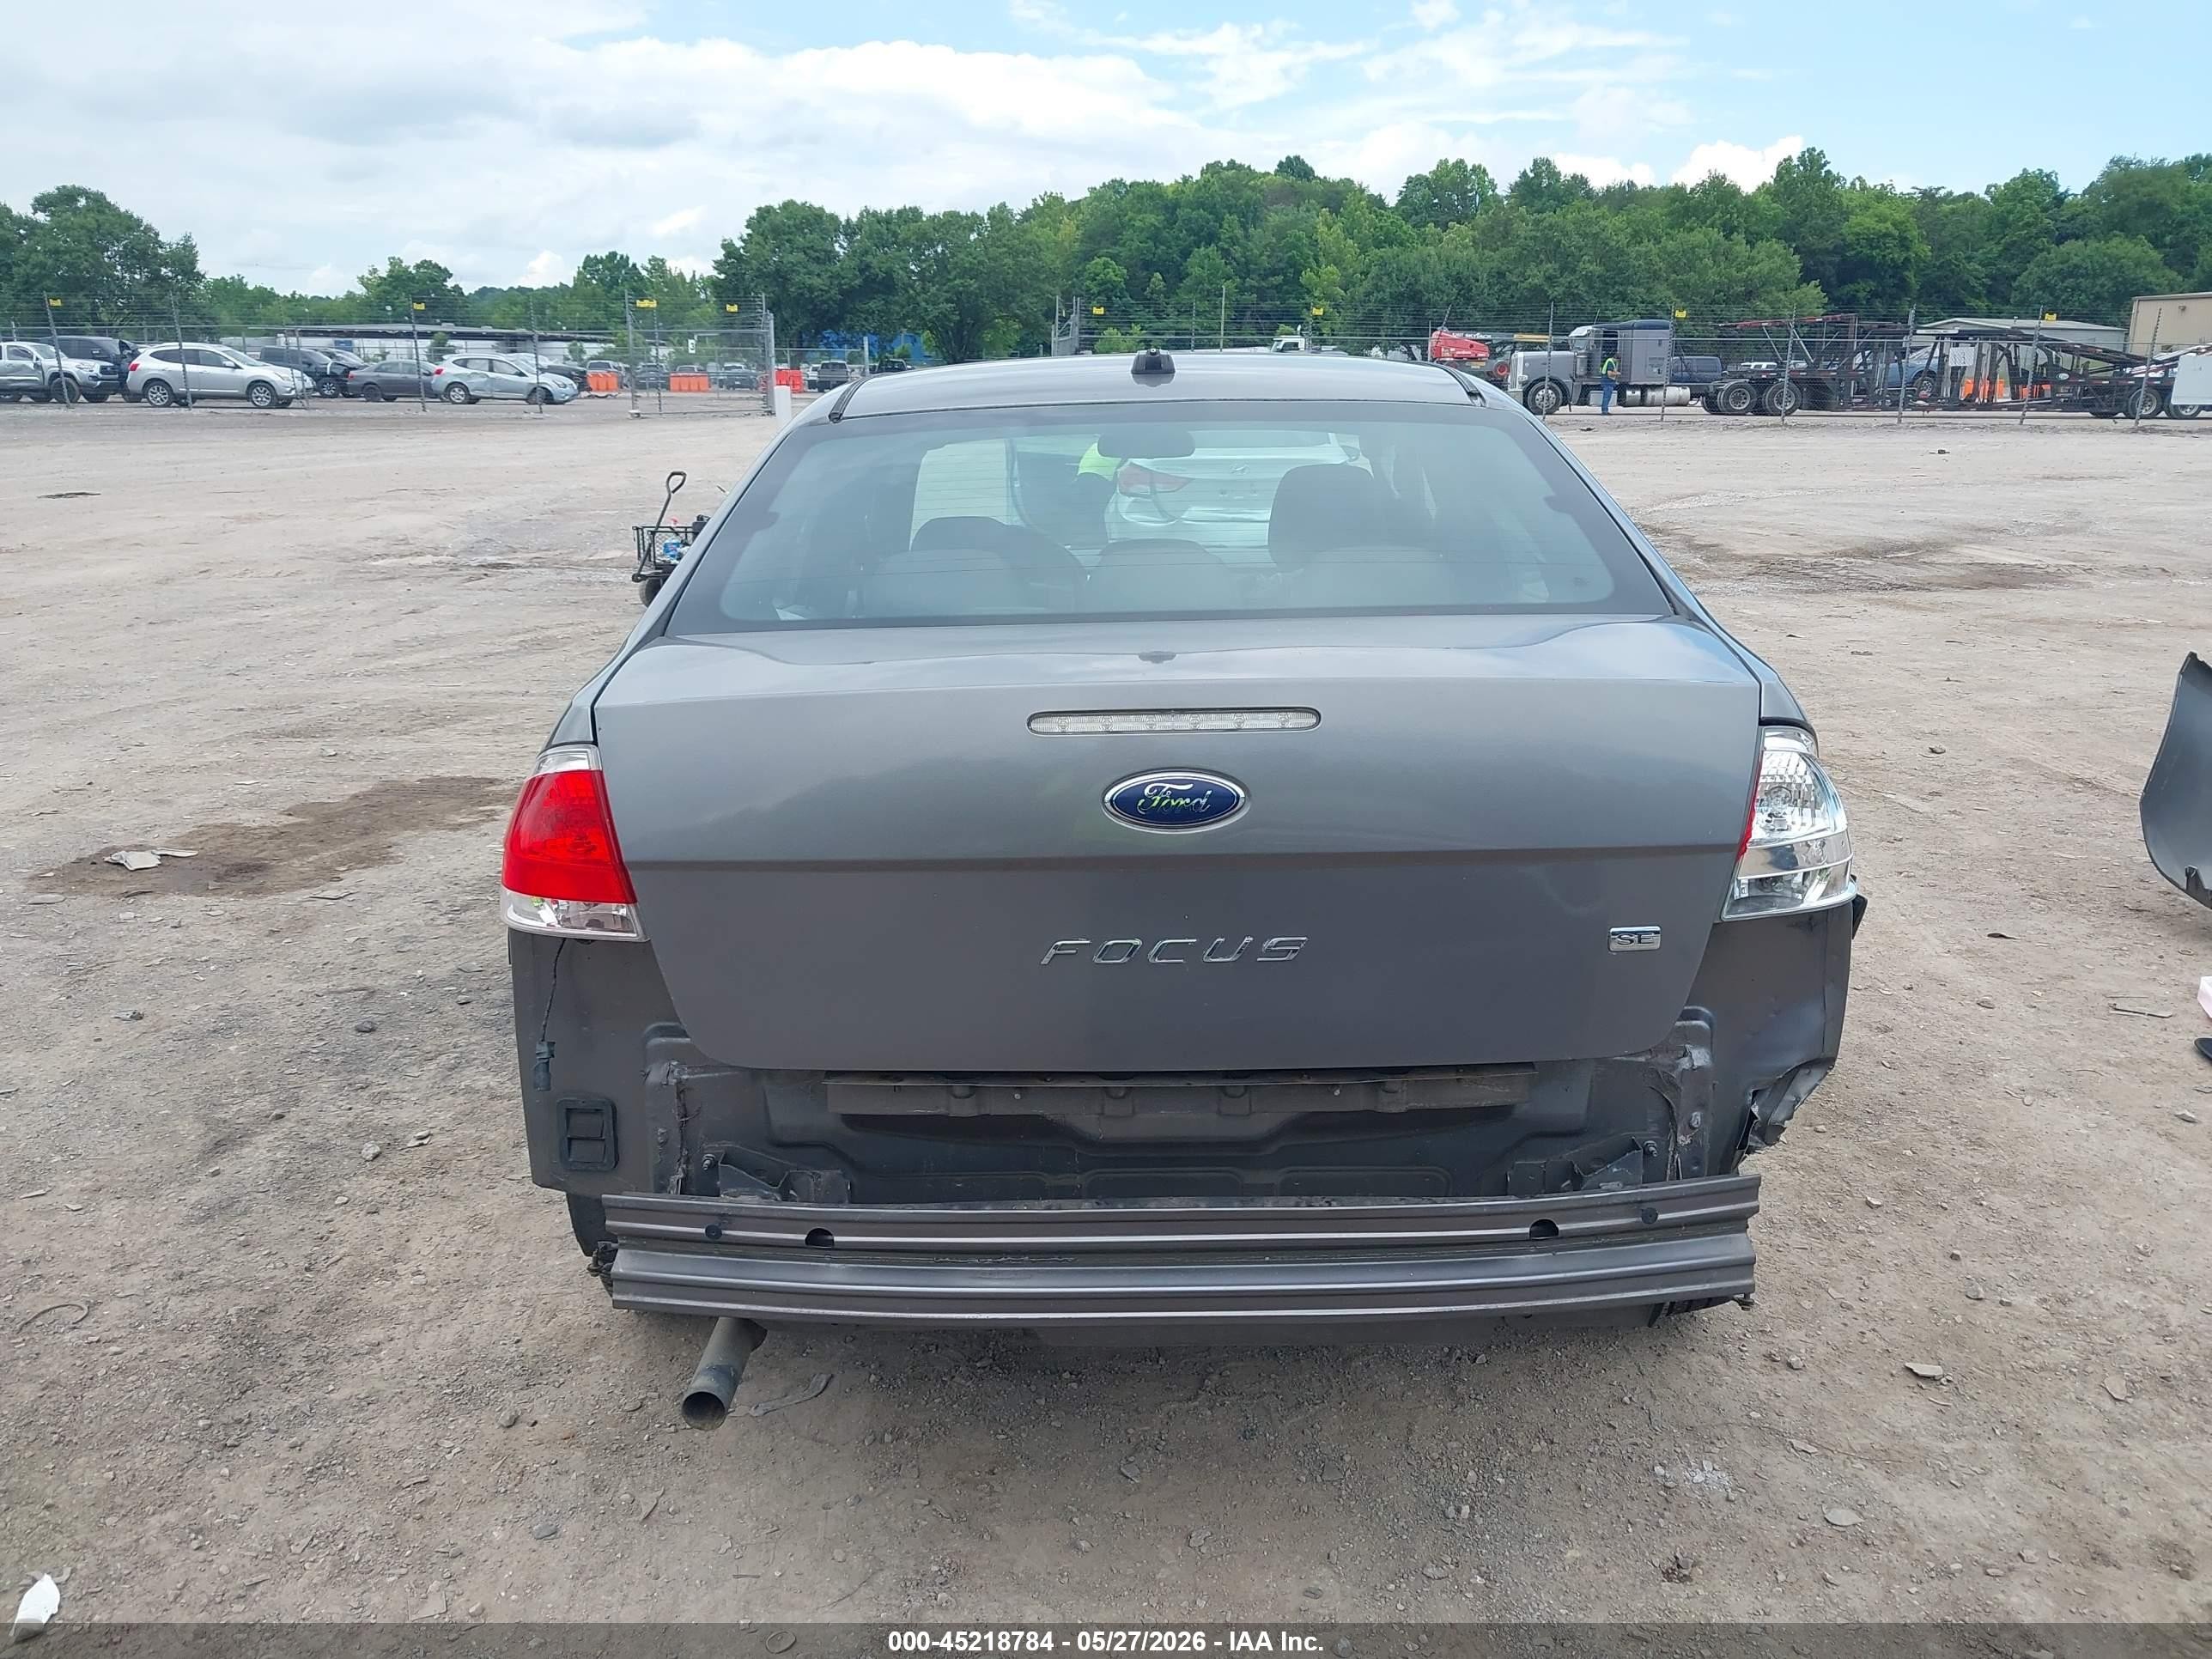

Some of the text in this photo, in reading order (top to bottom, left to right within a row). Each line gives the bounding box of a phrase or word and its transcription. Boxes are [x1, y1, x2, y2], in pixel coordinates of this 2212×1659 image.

[1137, 782, 1212, 815] Ford
[1040, 936, 1309, 965] FOCUS
[1616, 932, 1656, 945] SE
